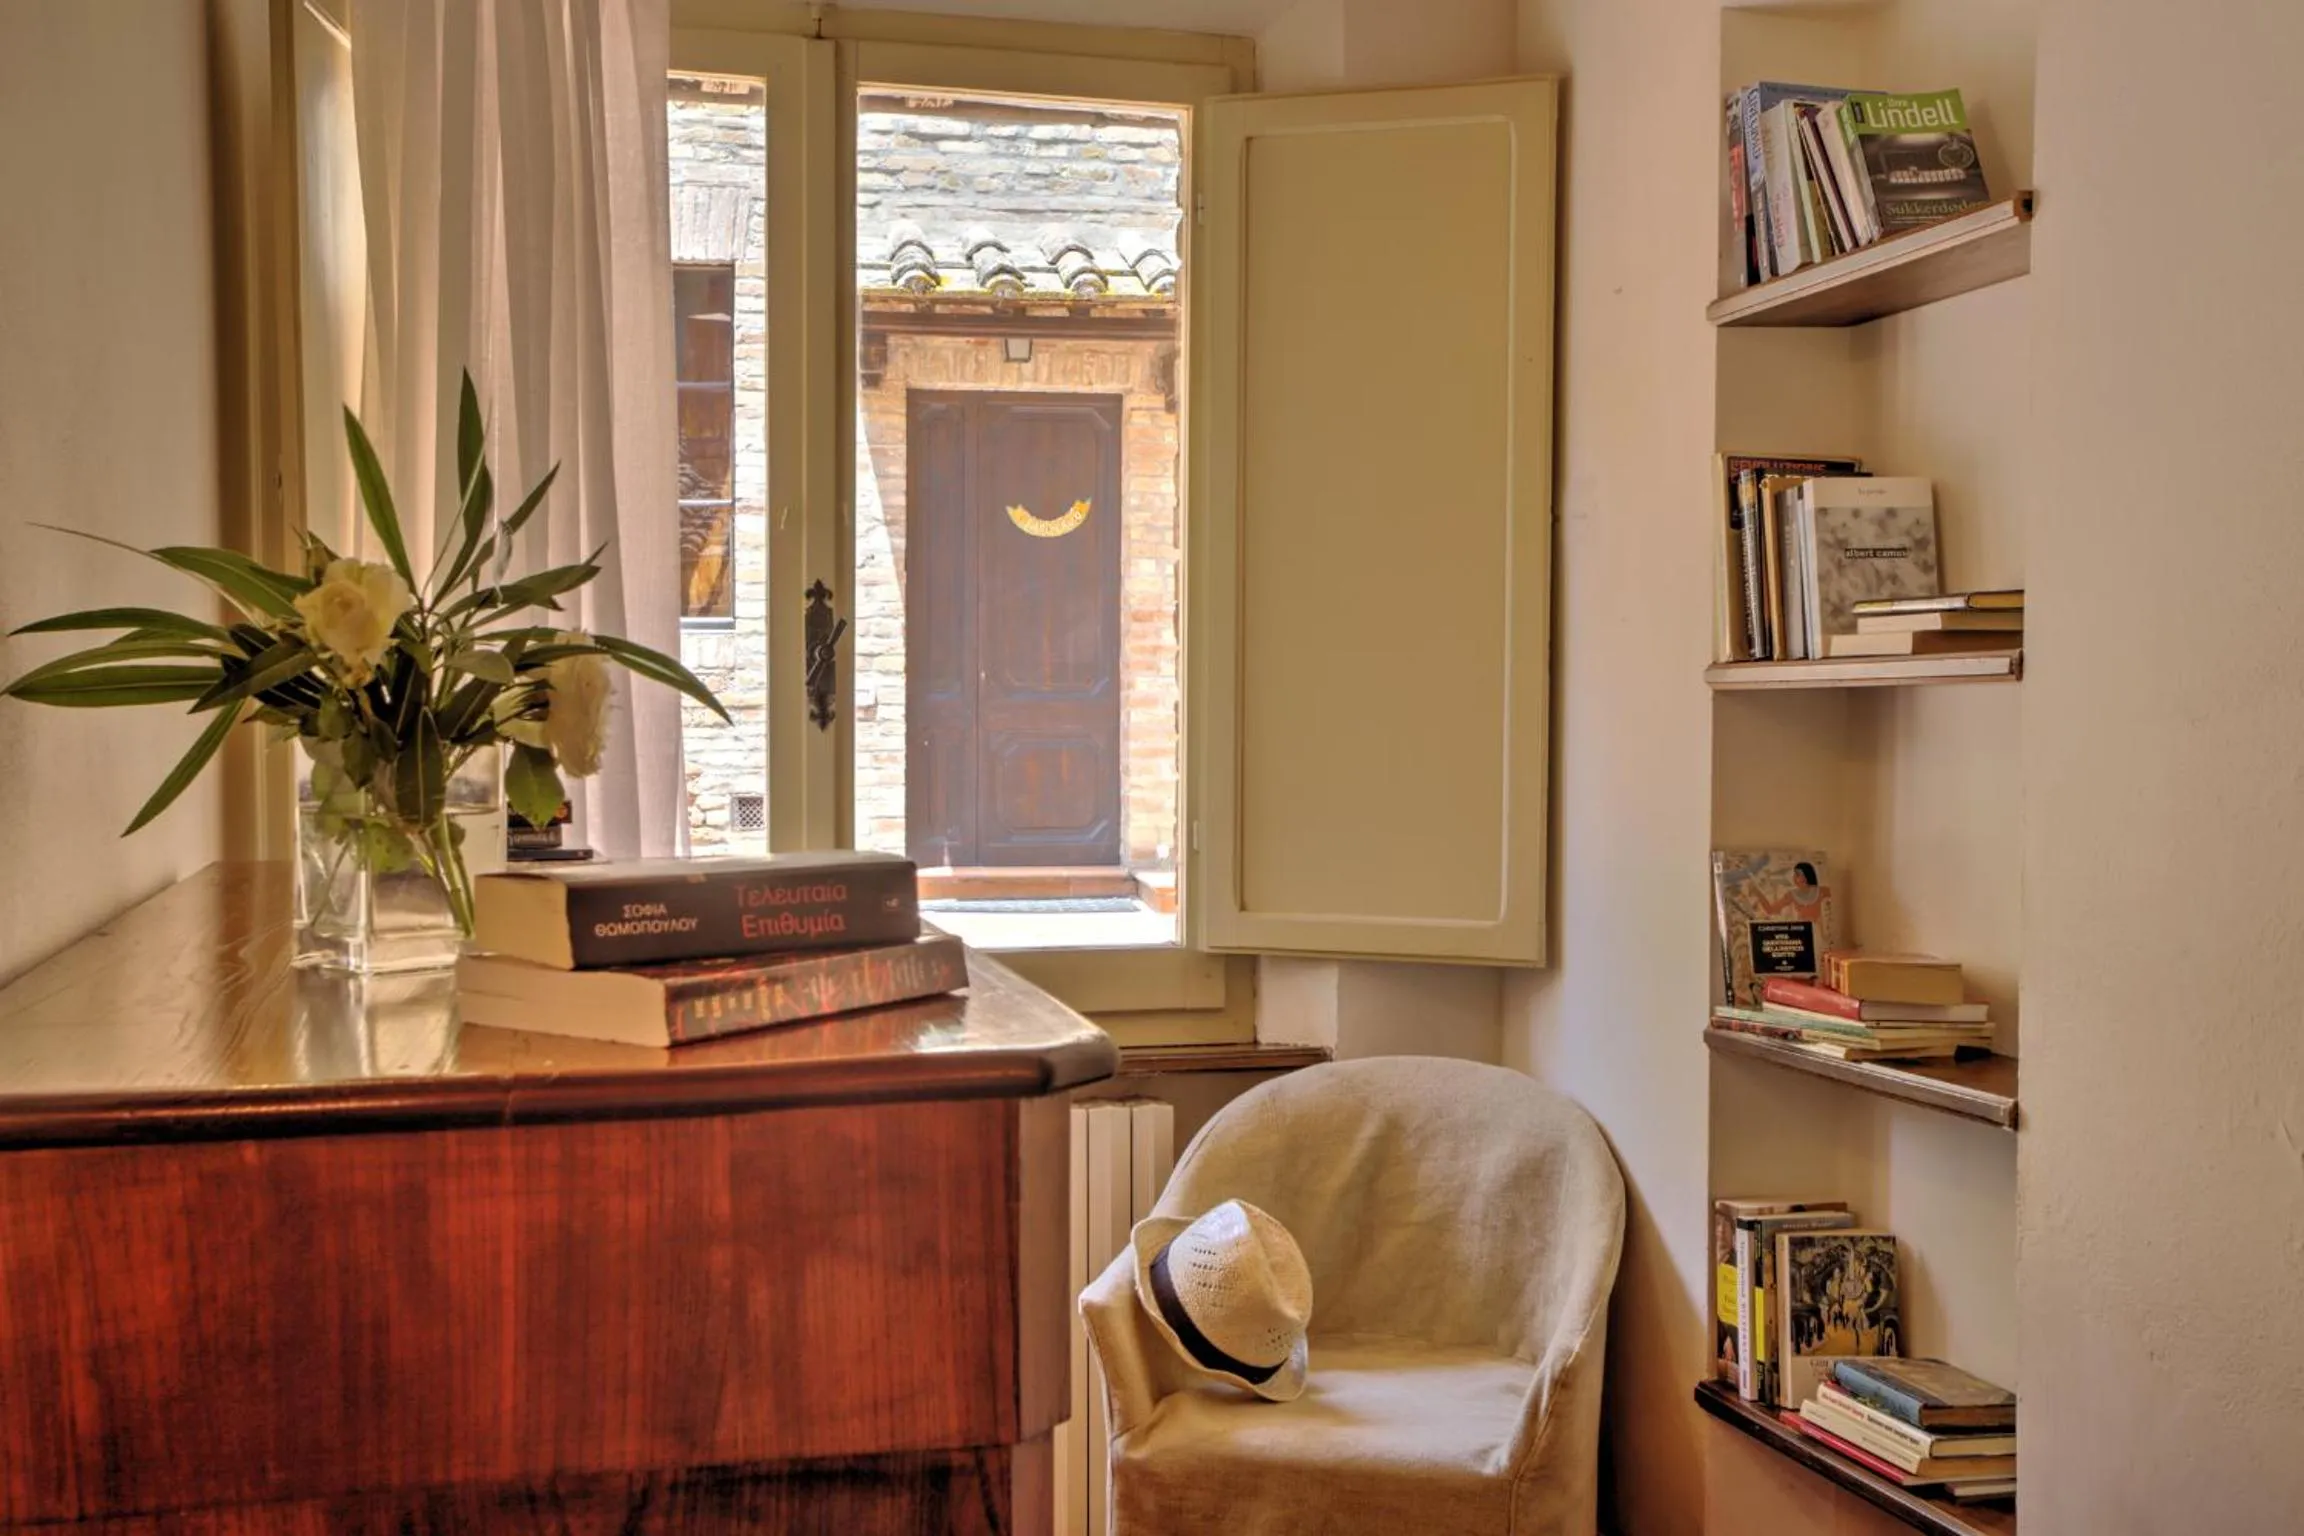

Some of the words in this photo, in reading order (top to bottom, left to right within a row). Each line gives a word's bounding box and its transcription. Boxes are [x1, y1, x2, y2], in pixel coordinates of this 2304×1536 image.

[1865, 98, 1960, 129] Lindell
[734, 882, 848, 908] Τελευταία
[622, 903, 668, 919] ΣΟΦΙΑ
[741, 909, 847, 939] Επιθυμία
[594, 917, 698, 938] ΘΩΜΟΠΟΥΛΟΥ
